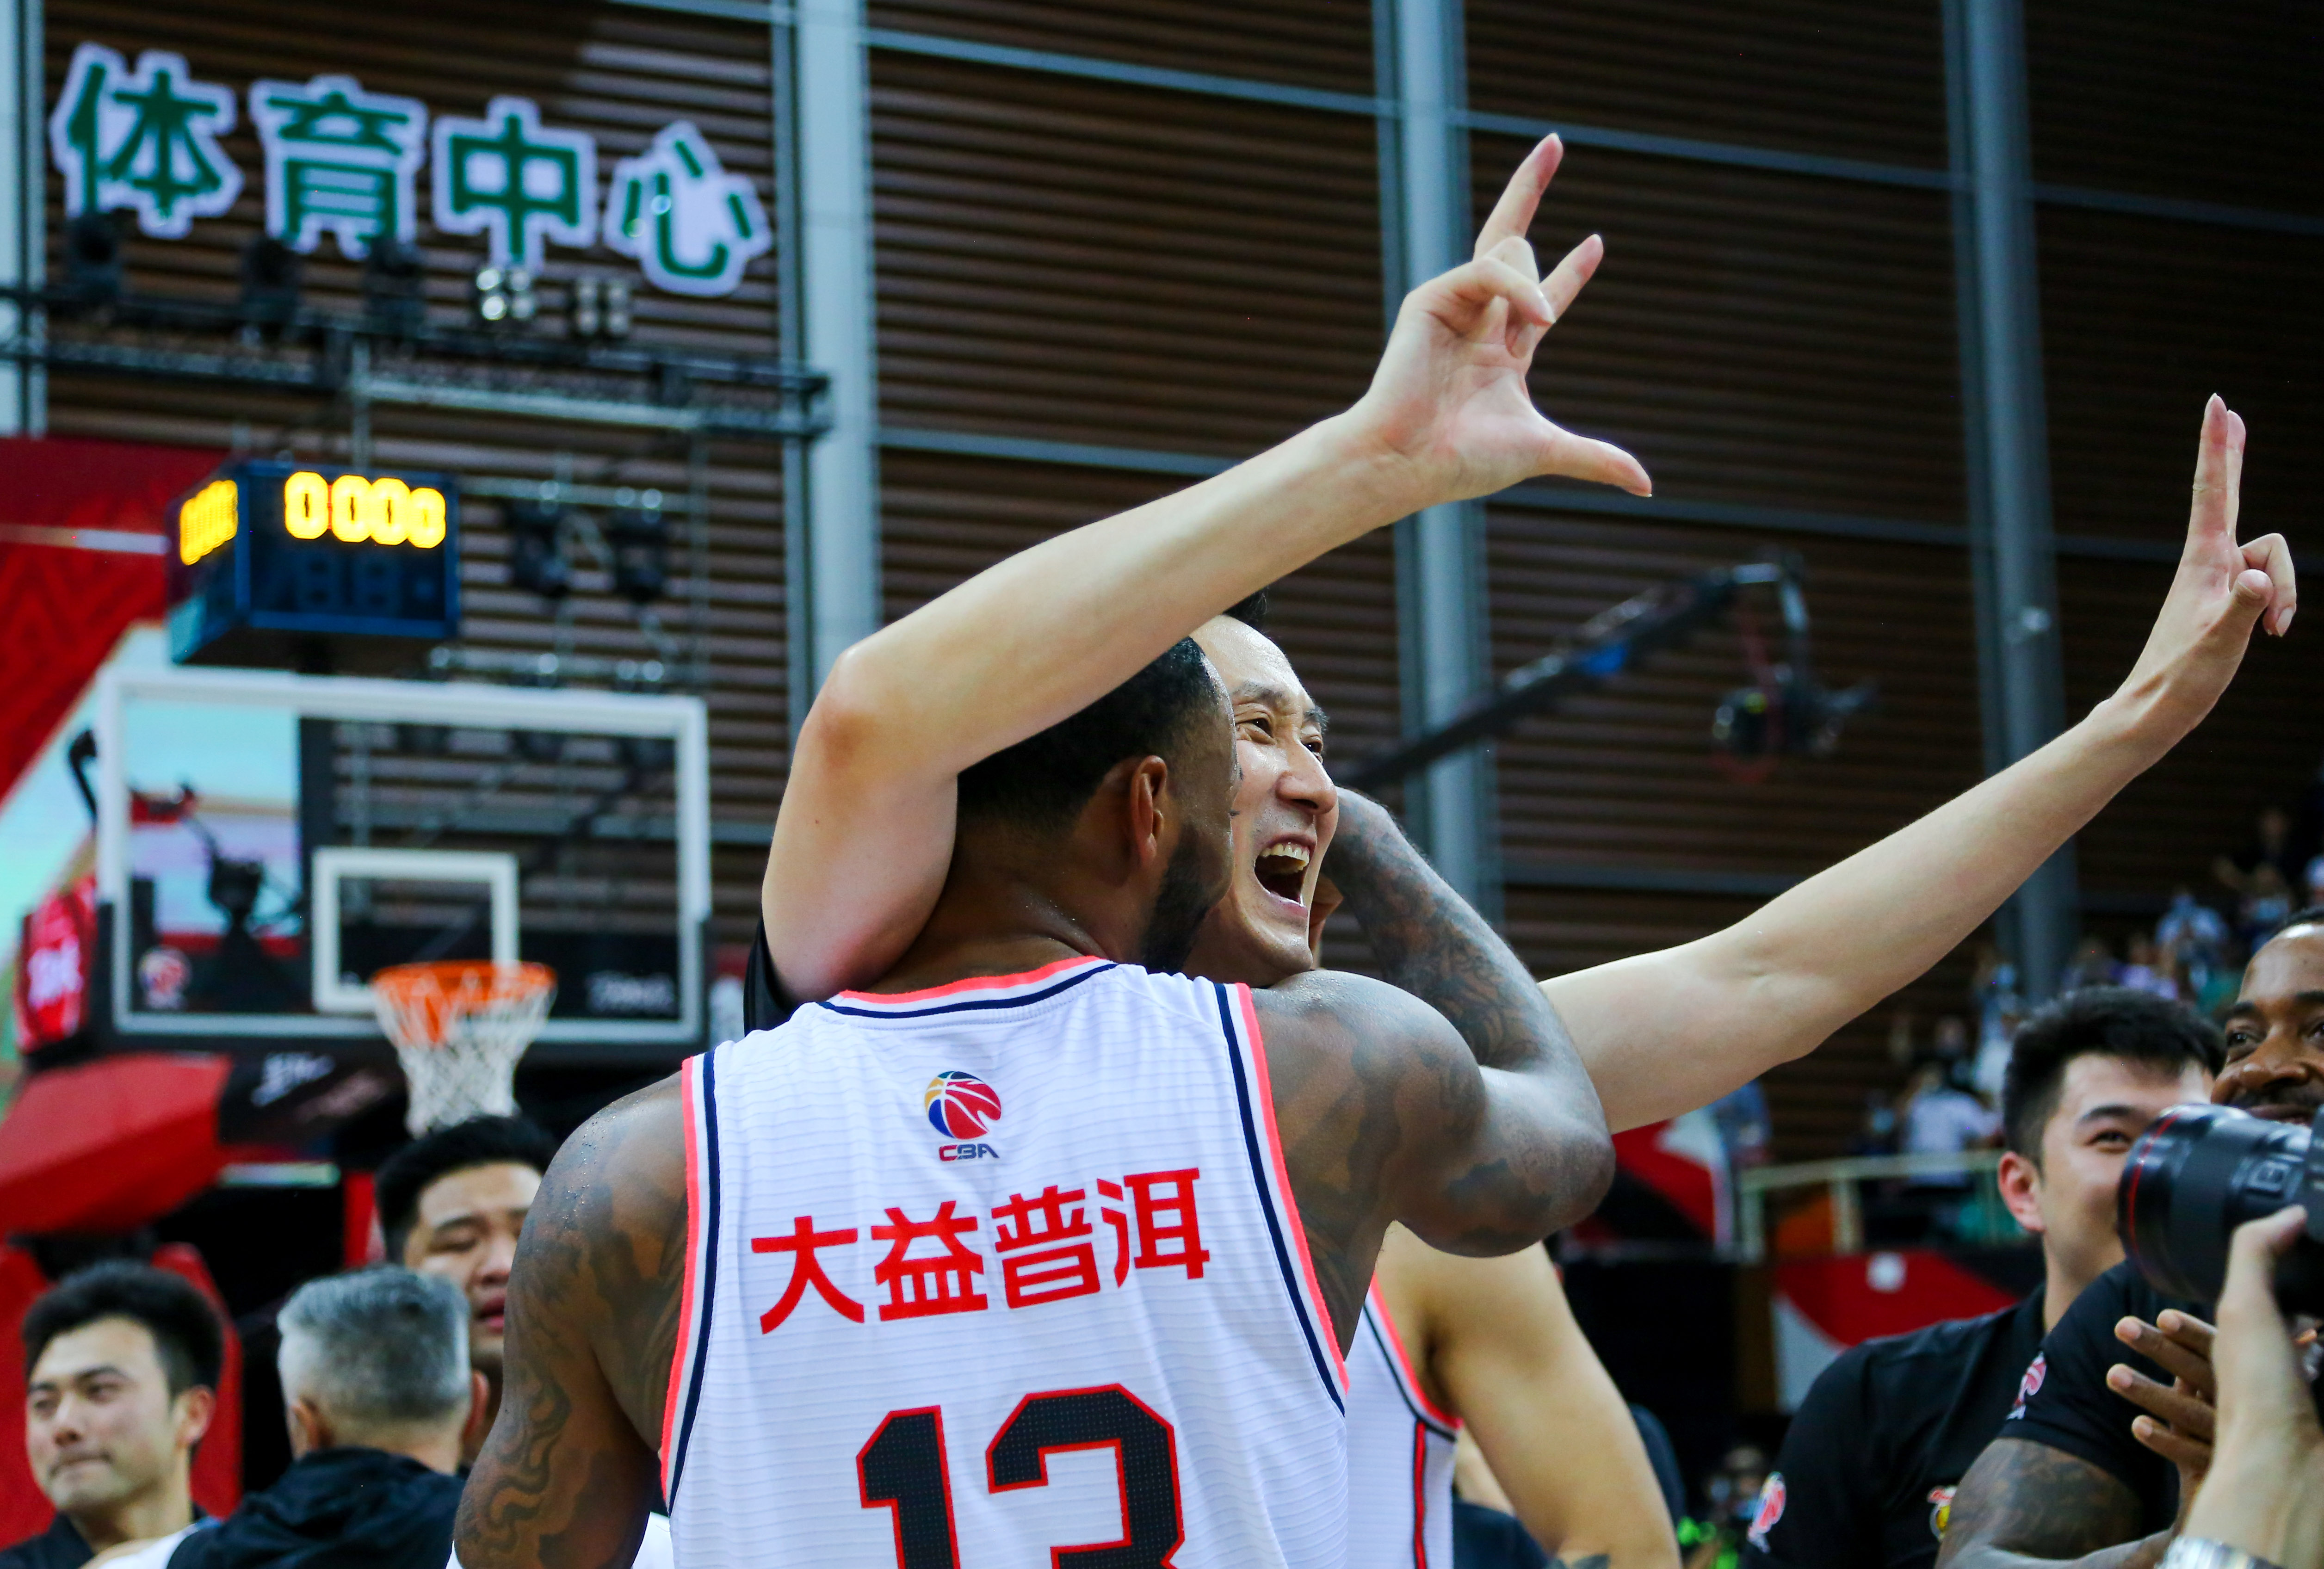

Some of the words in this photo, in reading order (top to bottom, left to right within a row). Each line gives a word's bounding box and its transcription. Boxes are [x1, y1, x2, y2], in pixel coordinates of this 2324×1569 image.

[64, 60, 756, 282] 体育中心
[939, 1143, 1000, 1162] CBA
[751, 1167, 1211, 1335] 大益普洱
[856, 1383, 1186, 1569] 13
